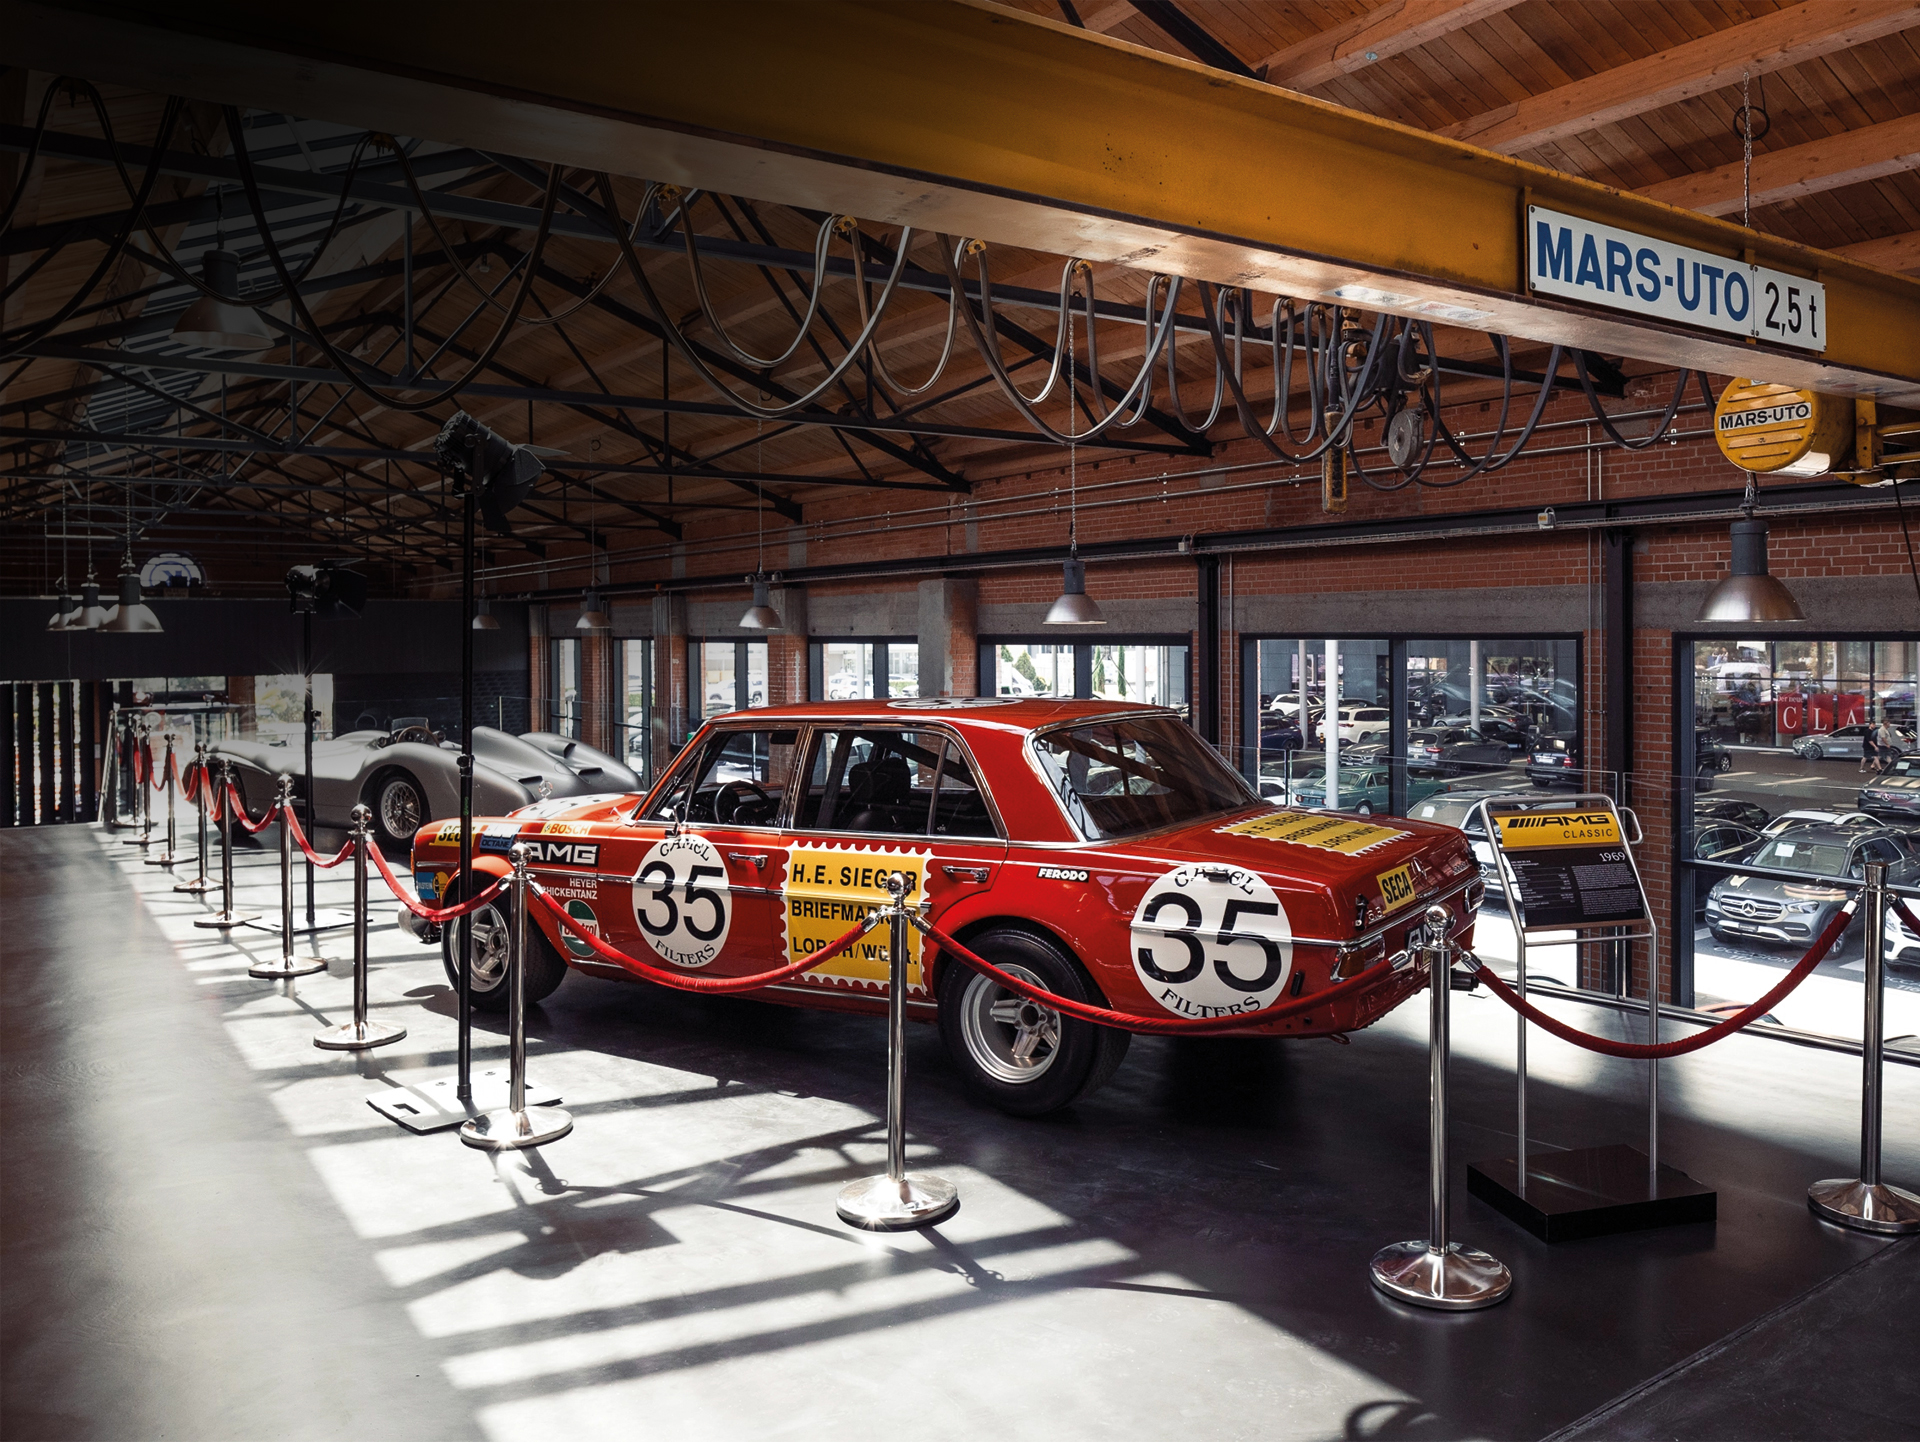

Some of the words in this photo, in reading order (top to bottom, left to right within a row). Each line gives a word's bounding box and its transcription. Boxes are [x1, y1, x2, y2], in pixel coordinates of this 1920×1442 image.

[1536, 220, 1750, 323] MARS-UTO
[1764, 281, 1801, 337] 2,5
[1808, 294, 1818, 339] t
[1720, 404, 1809, 430] MARS-UTO
[550, 823, 590, 835] BOSCH
[1540, 815, 1610, 827] AMG
[481, 839, 510, 849] OCTANE
[1563, 828, 1613, 839] CLASSIC
[526, 841, 598, 865] AMG
[1599, 851, 1626, 862] 1969
[569, 878, 598, 889] HEYER
[792, 863, 833, 885] H.E.
[1037, 867, 1088, 881] FERODO
[1381, 871, 1413, 905] SECA
[636, 860, 726, 942] 35
[655, 939, 716, 965] FILTERS
[1138, 891, 1282, 993] 35
[1160, 987, 1261, 1019] FILTERS
